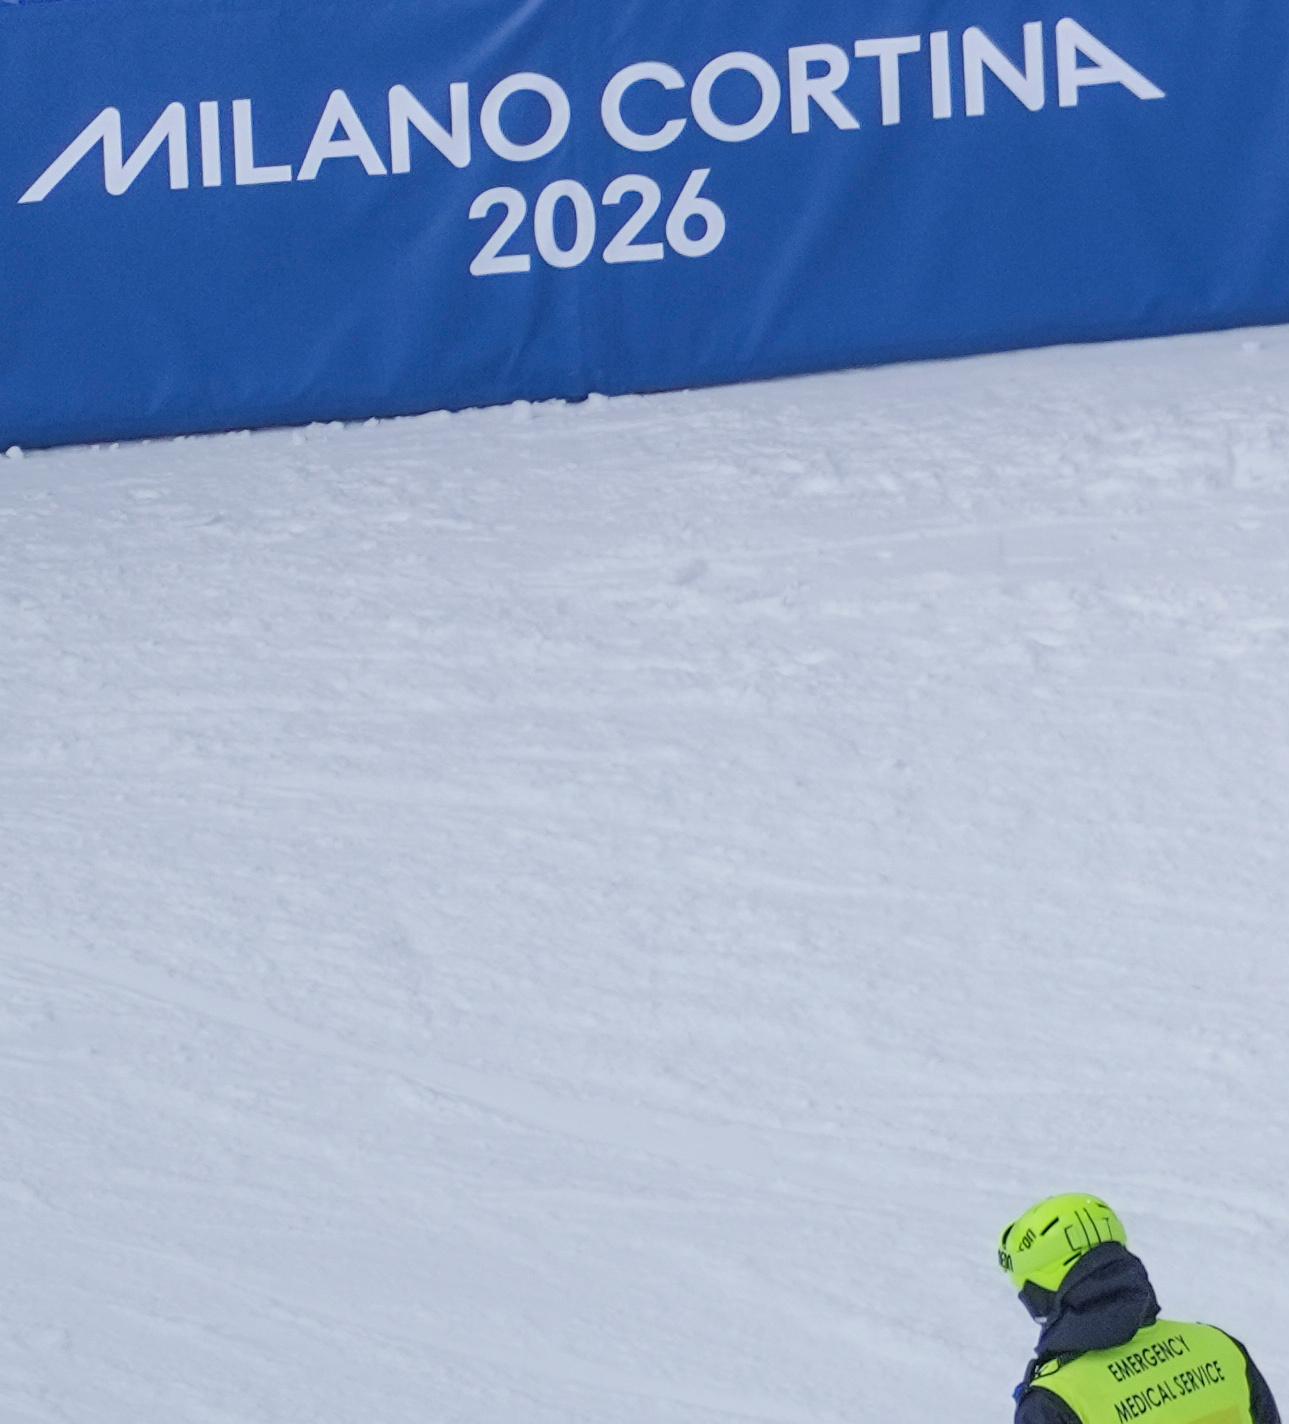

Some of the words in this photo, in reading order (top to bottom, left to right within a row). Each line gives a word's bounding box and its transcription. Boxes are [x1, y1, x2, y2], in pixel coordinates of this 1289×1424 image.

[19, 71, 570, 204] MILANO
[601, 16, 1166, 152] CORTINA
[468, 168, 726, 276] 2026
[1107, 1334, 1190, 1382] EMERGENCY
[1114, 1380, 1177, 1424] MEDICAL
[1173, 1360, 1225, 1395] SERVICE
